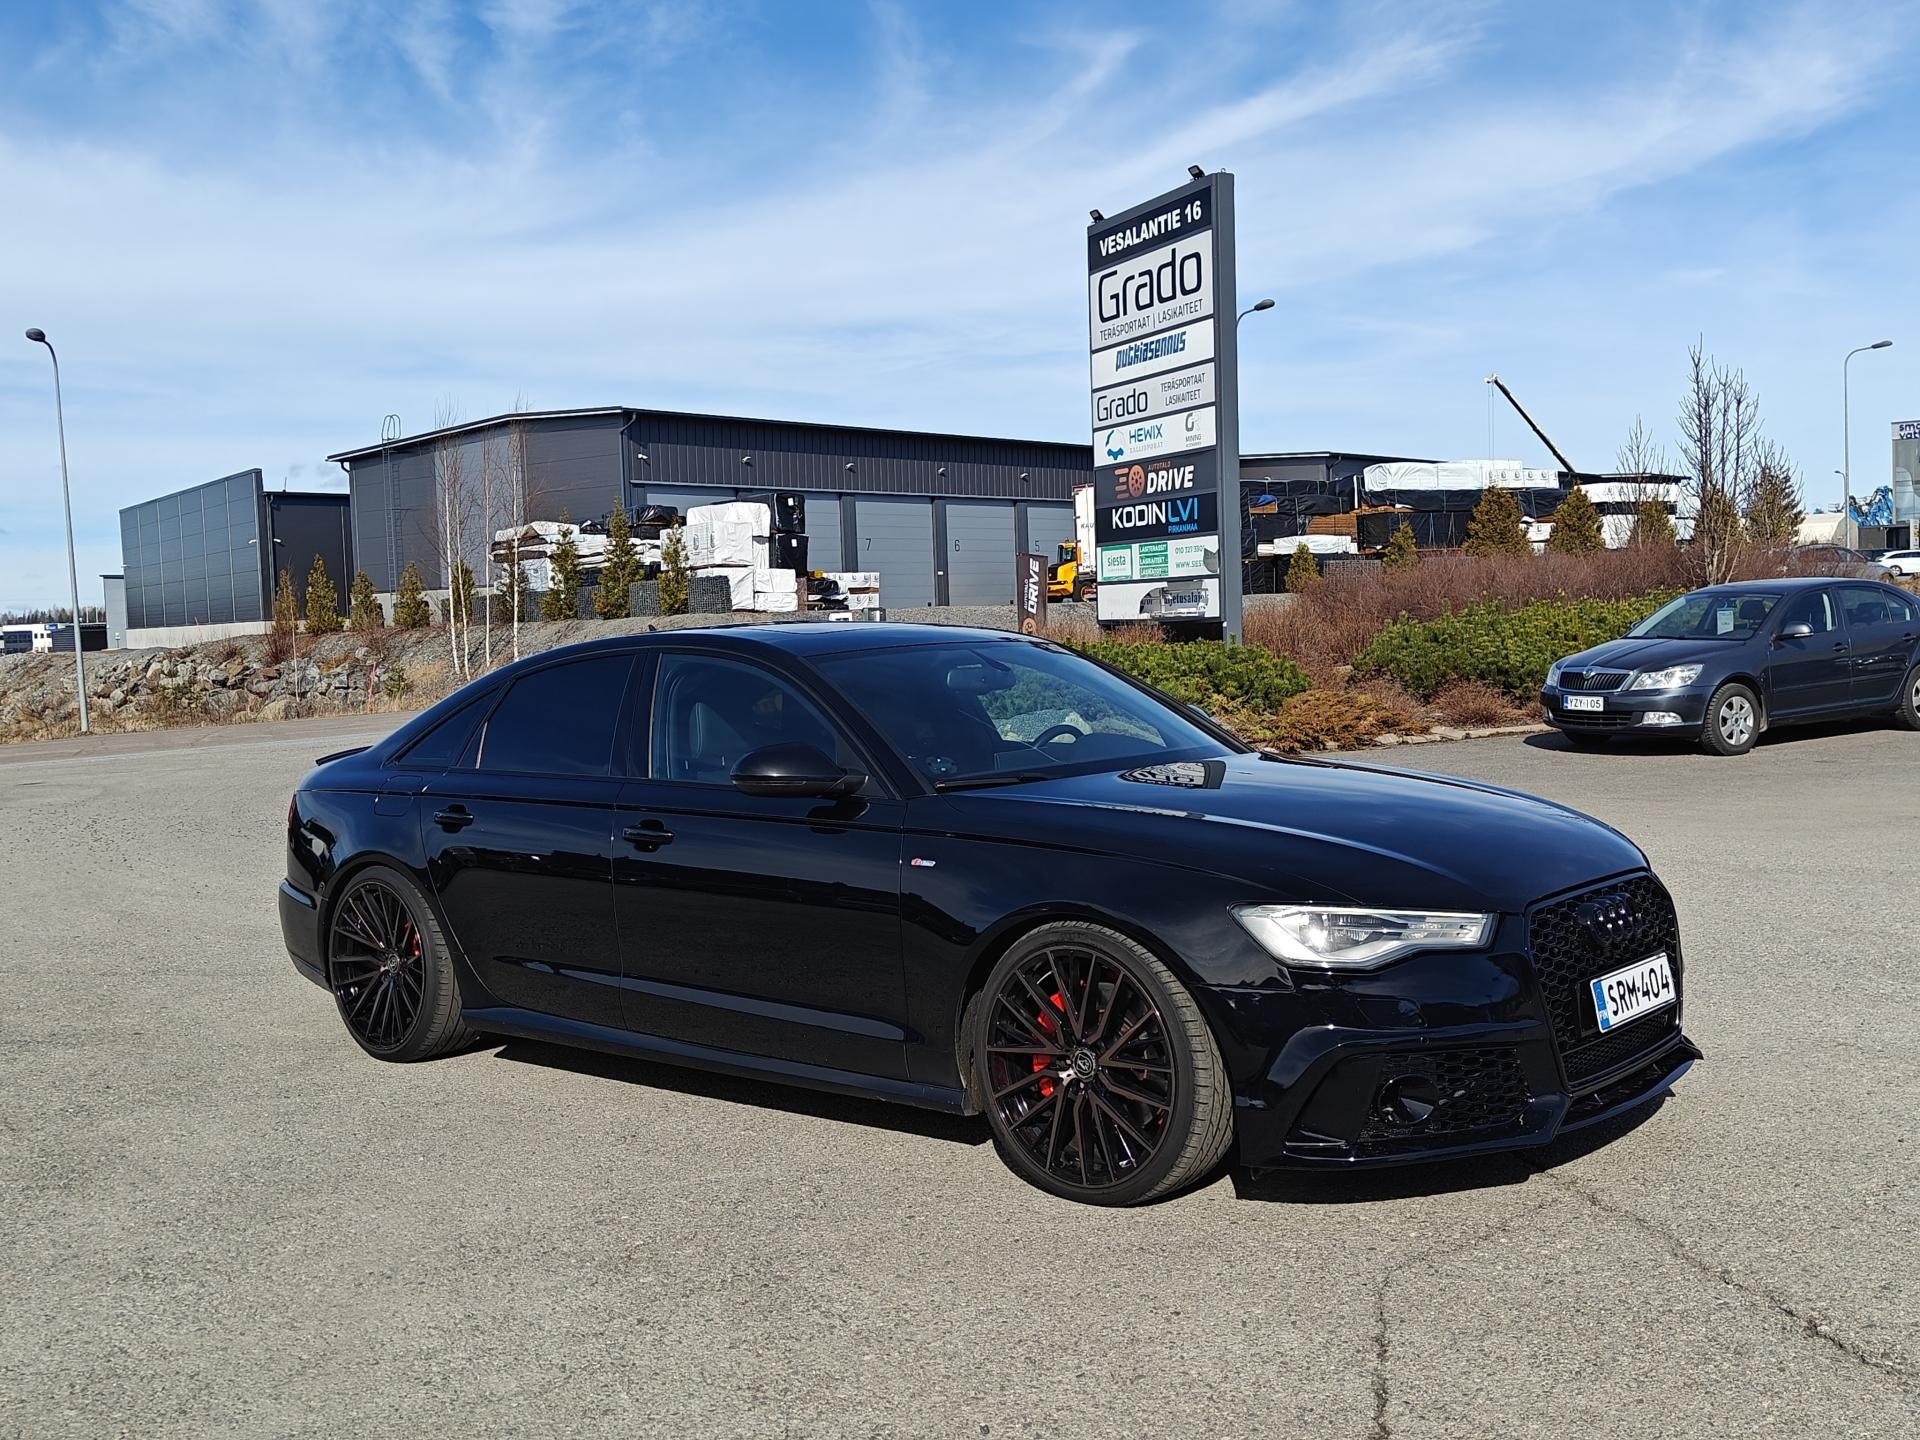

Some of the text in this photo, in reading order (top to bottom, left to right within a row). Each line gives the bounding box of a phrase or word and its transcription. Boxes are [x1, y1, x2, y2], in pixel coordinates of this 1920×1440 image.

[1100, 200, 1202, 256] VESALANTIE 16
[1098, 248, 1202, 323] Grado
[1100, 299, 1203, 341] TERÄSPORTAAT LASIKAITEET
[1161, 373, 1206, 392] TERÄSPORTAAT
[1097, 388, 1148, 422] Grado
[1165, 389, 1201, 406] LASIKAITEET
[1129, 424, 1163, 444] HEWIX
[1147, 465, 1195, 494] DRIVE
[1168, 523, 1198, 534] PIRKANMAA
[865, 538, 872, 551] 7
[954, 539, 960, 552] 6
[1034, 540, 1040, 552] 5
[1107, 555, 1126, 567] siesta
[1028, 558, 1040, 615] DRIVE
[1608, 964, 1670, 1016] SRM-404
